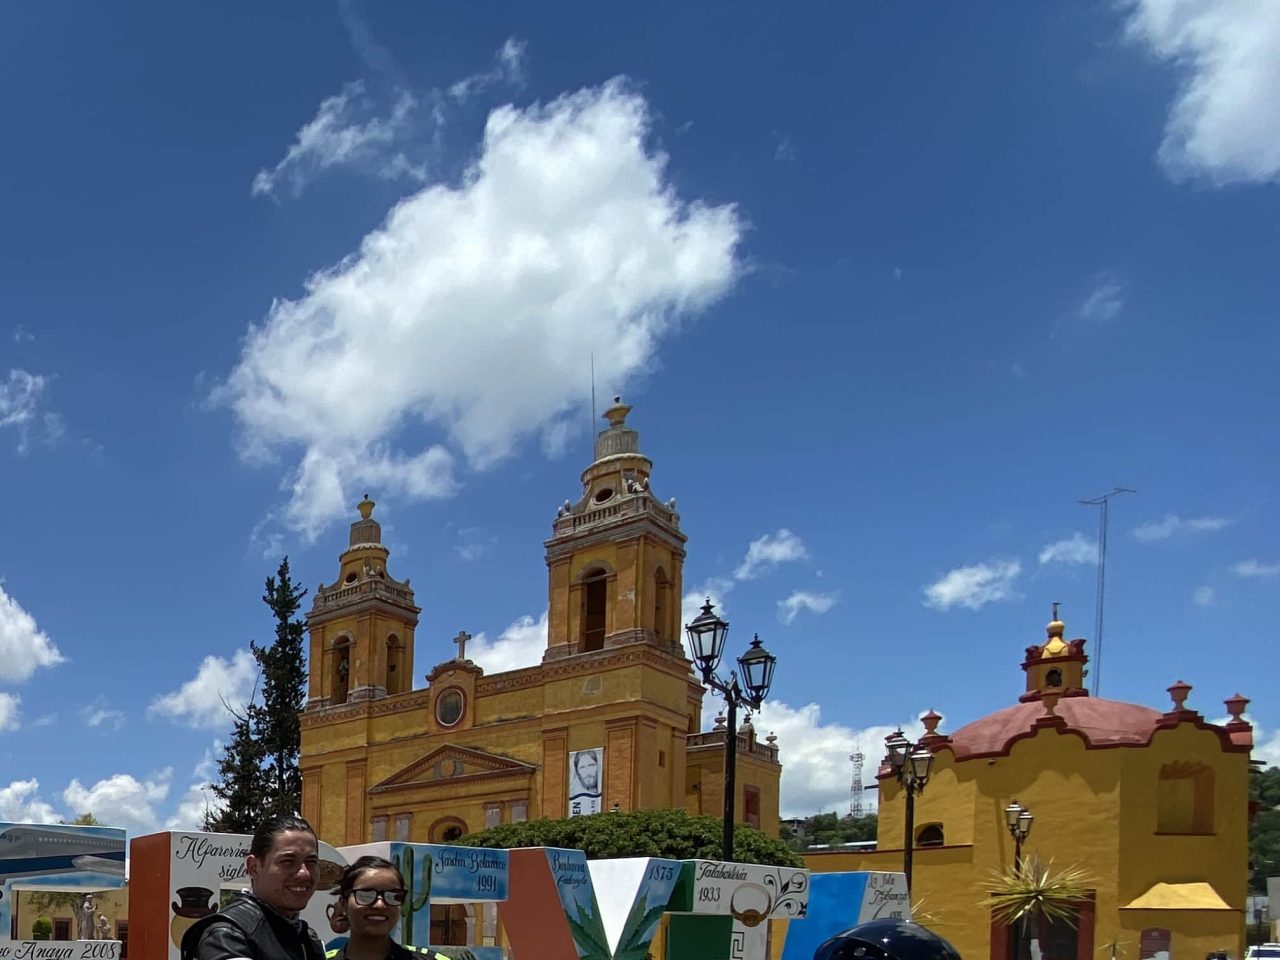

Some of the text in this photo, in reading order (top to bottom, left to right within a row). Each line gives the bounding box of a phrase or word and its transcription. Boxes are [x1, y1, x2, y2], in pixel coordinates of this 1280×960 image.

[647, 864, 674, 881] 1875
[477, 875, 497, 892] 1991
[698, 887, 721, 902] 1933
[80, 943, 117, 960] 2008
